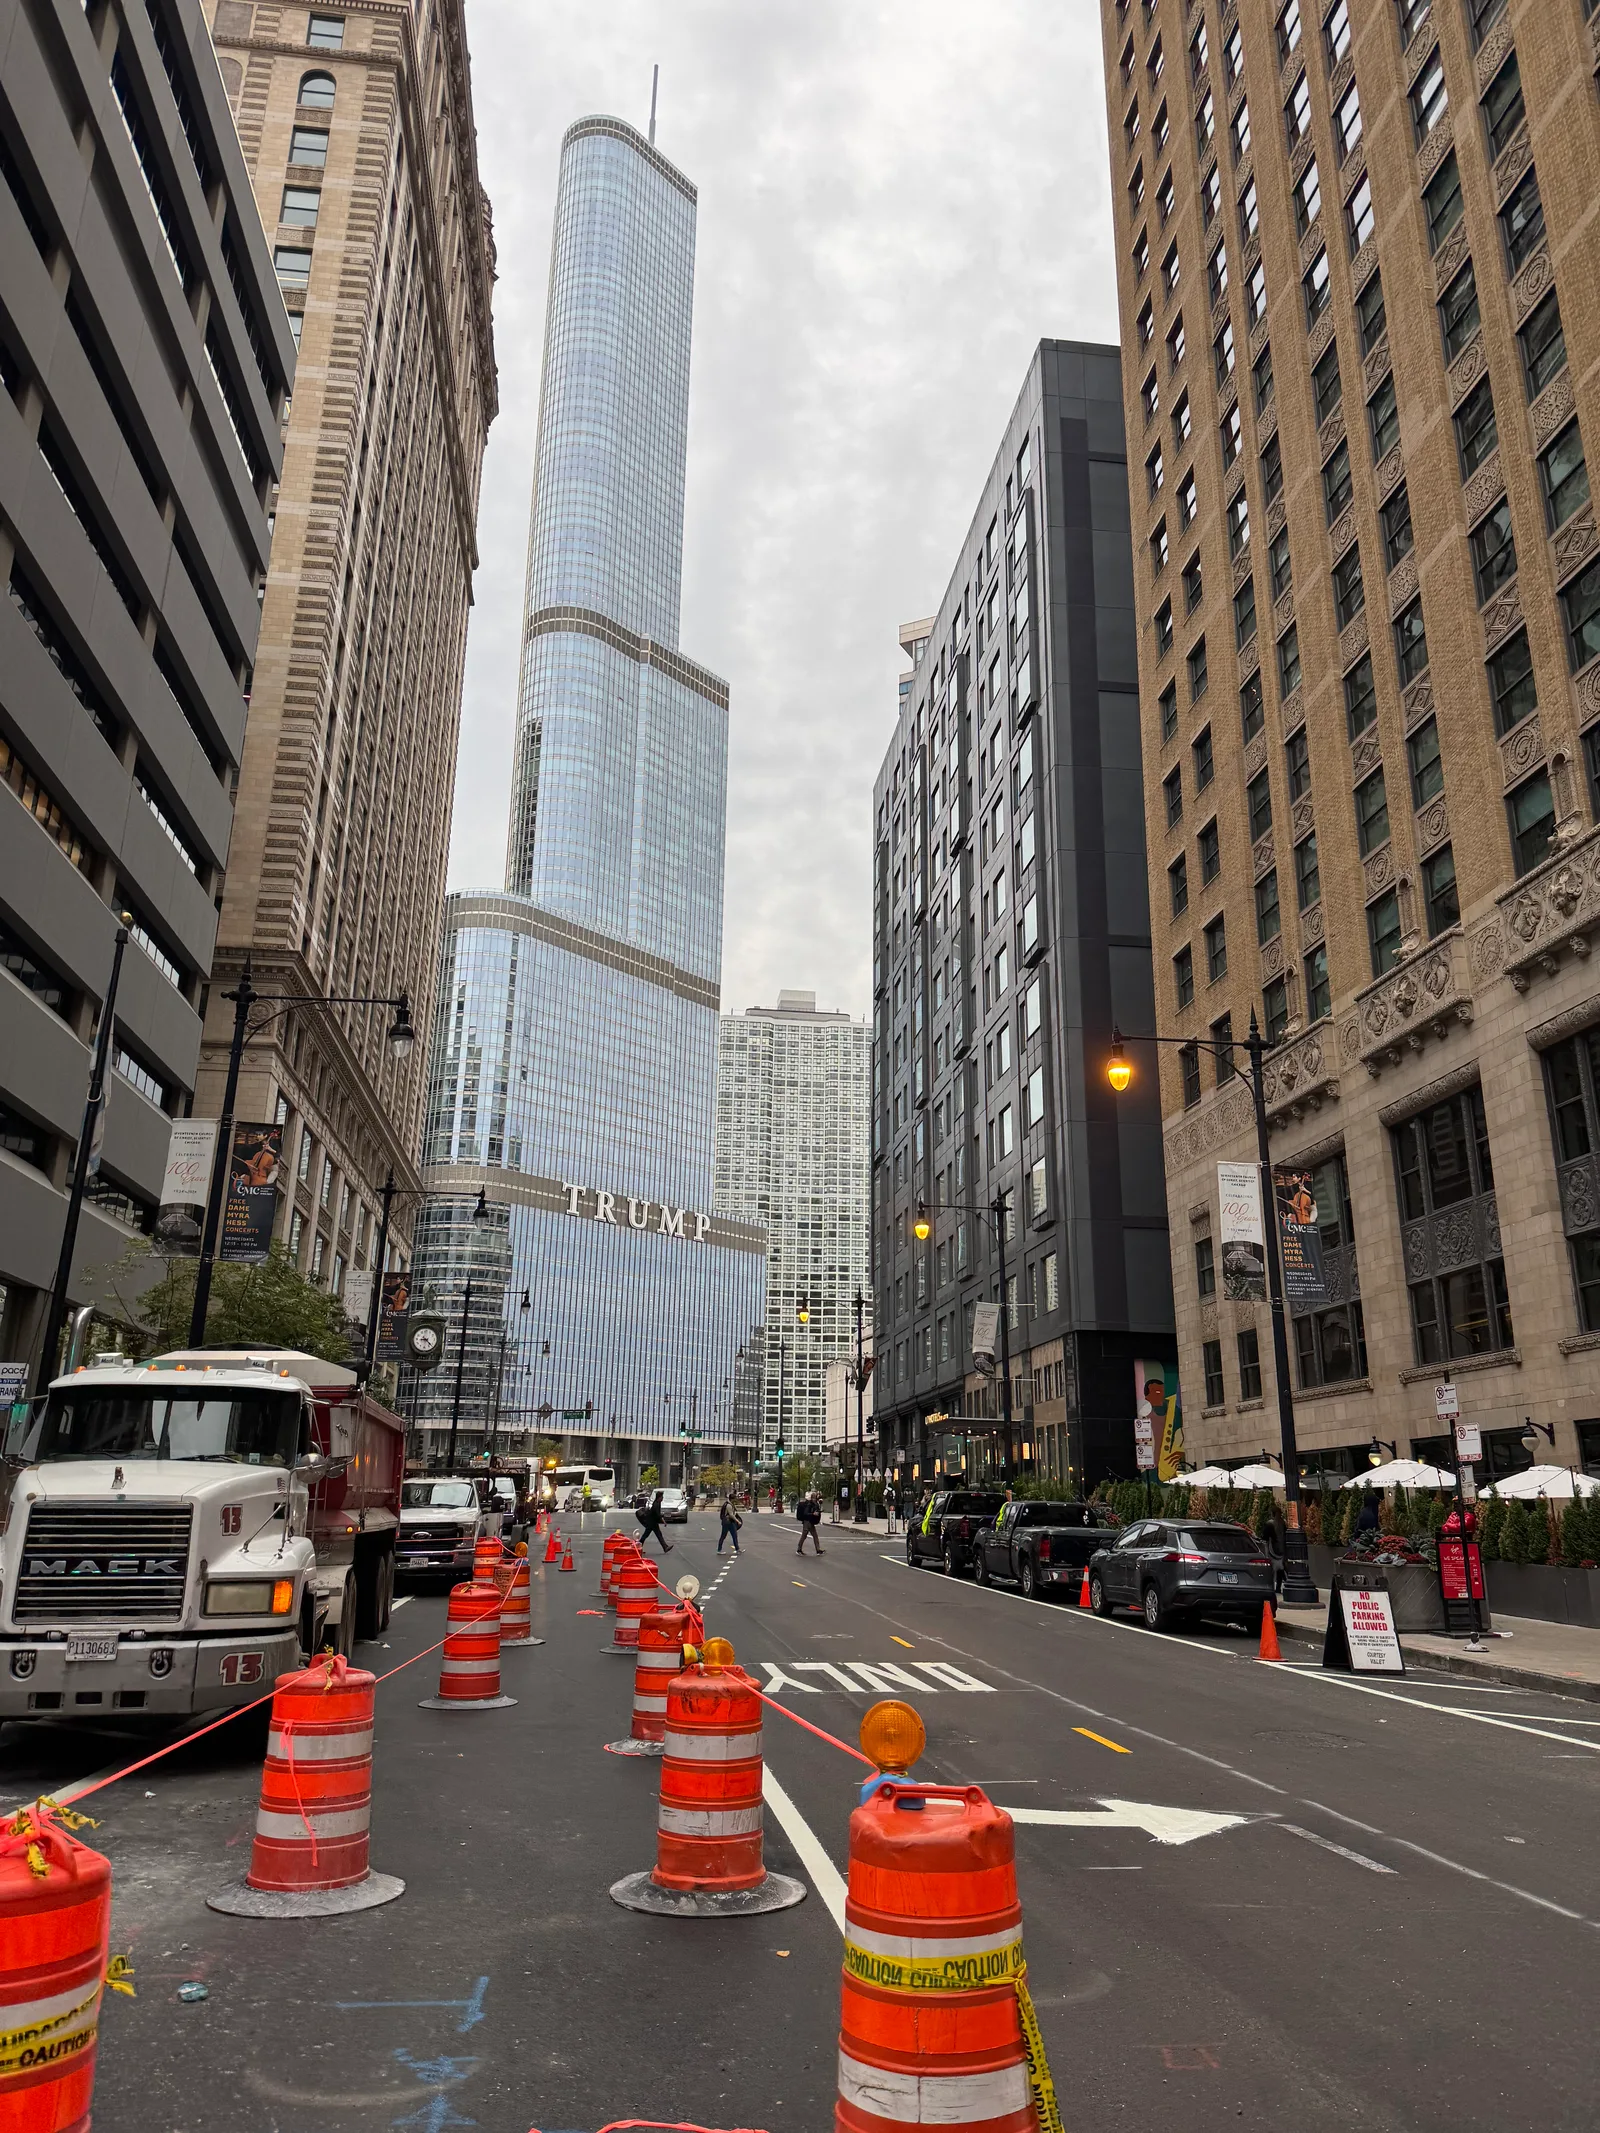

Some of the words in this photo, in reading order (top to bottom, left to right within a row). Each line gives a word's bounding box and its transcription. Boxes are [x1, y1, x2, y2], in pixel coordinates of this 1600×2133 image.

[167, 1161, 200, 1175] 100
[237, 1185, 260, 1196] CMC
[228, 1204, 250, 1212] DAME
[562, 1182, 711, 1242] TRUMP
[1222, 1202, 1250, 1215] 100
[1288, 1225, 1307, 1234] CMC
[1, 1367, 25, 1375] pace
[220, 1504, 243, 1536] 13
[29, 1560, 180, 1574] MACK
[1359, 1592, 1371, 1600] NO
[1352, 1601, 1379, 1610] PUBLIC
[1351, 1611, 1385, 1620] PARKING
[1353, 1621, 1388, 1631] ALLOWED
[1366, 1651, 1386, 1659] COURTESY
[219, 1651, 264, 1687] 13
[761, 1662, 998, 1692] ONLY
